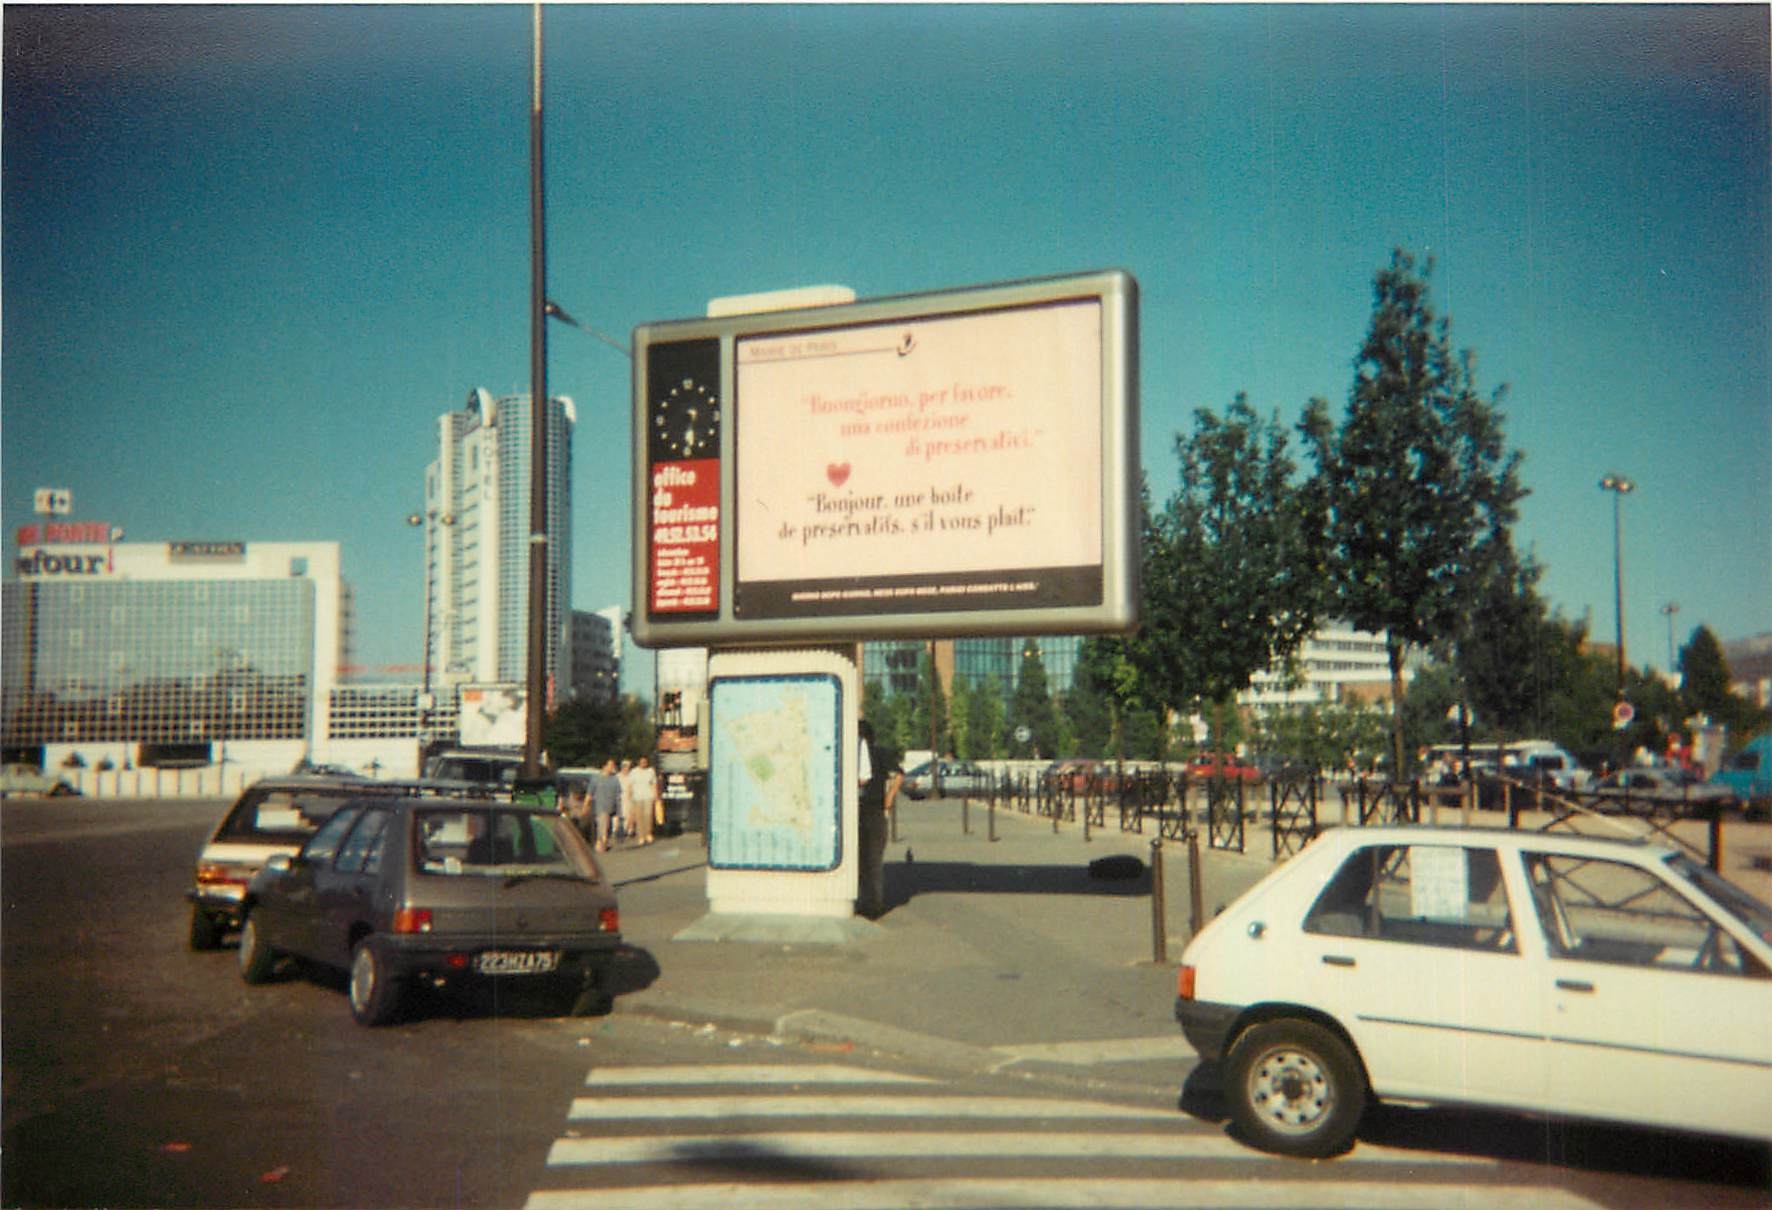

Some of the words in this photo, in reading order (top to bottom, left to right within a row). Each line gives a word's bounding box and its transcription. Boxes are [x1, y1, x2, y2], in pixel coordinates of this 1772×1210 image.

[918, 390, 947, 413] per
[840, 422, 871, 438] una
[875, 413, 969, 434] confezione
[653, 466, 697, 488] office
[894, 493, 925, 508] une
[653, 503, 719, 525] tourisme
[778, 521, 797, 539] de
[939, 516, 981, 531] vous
